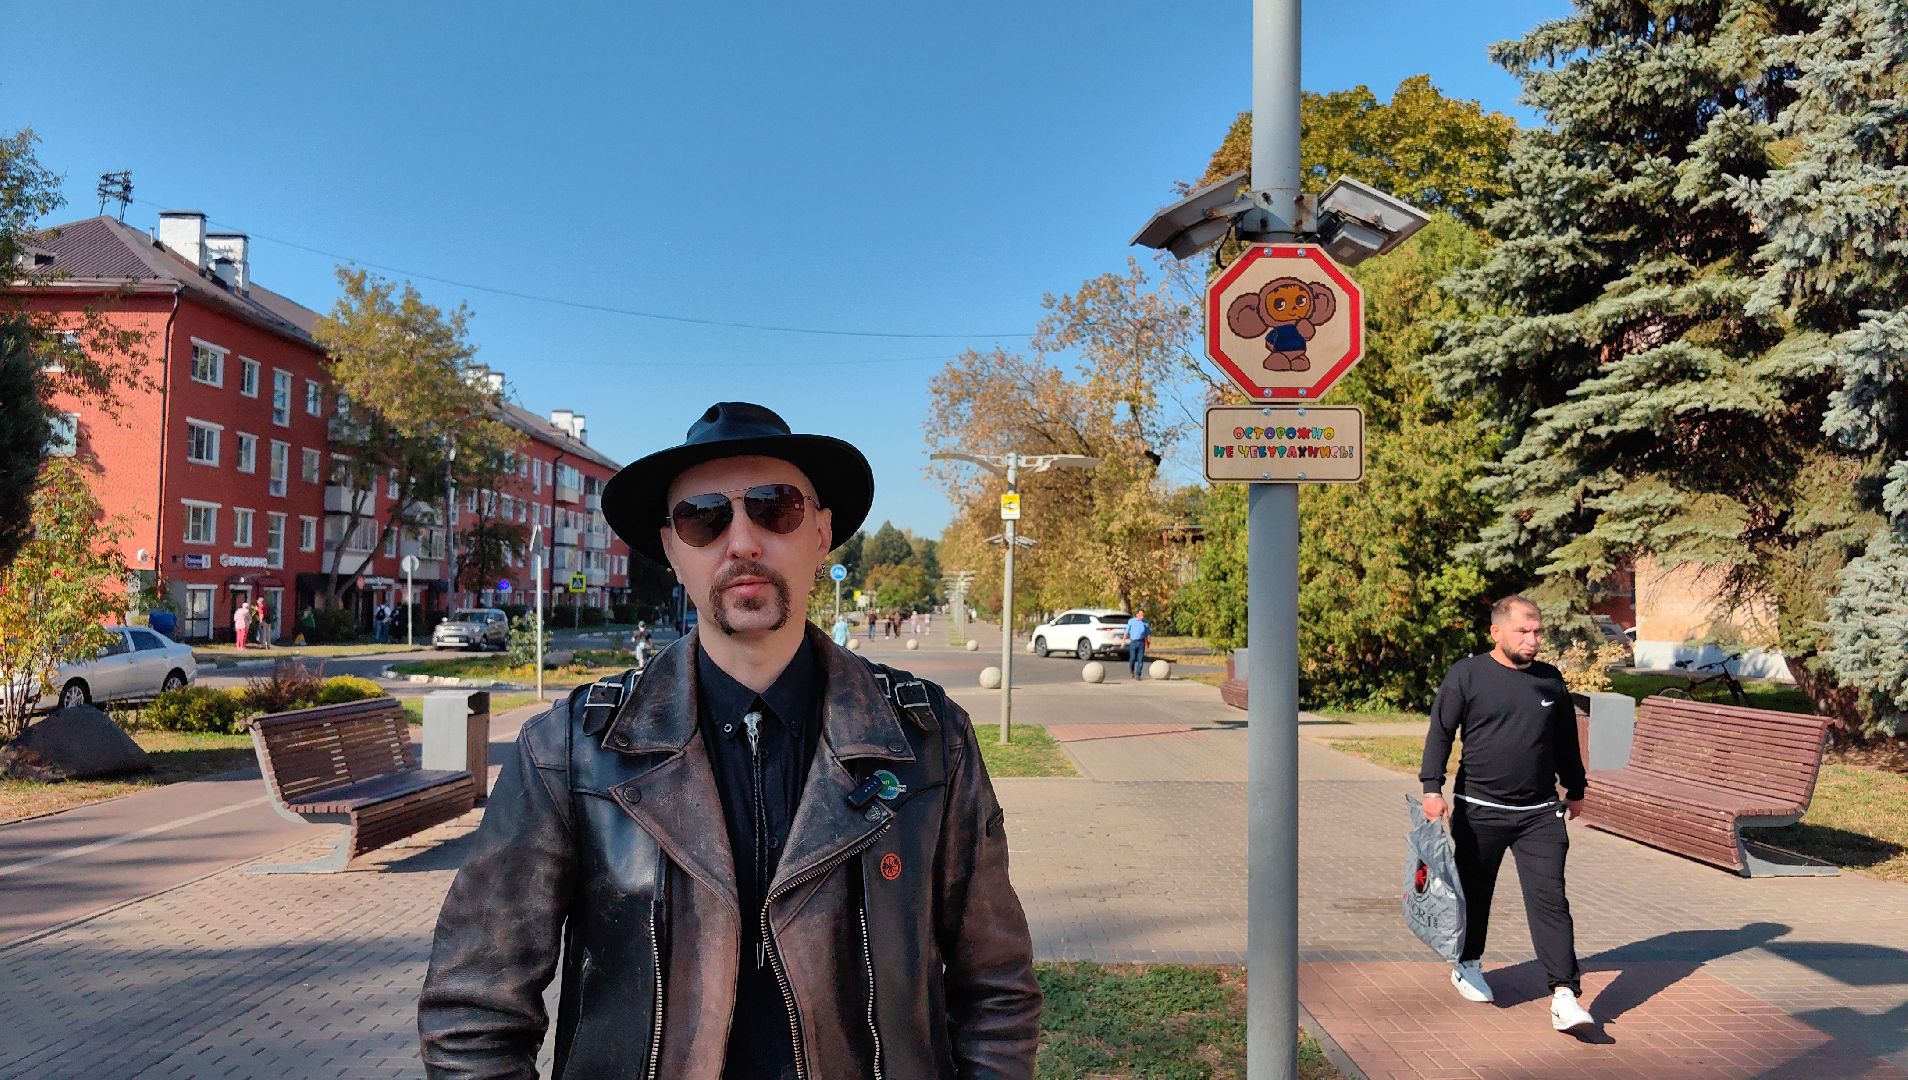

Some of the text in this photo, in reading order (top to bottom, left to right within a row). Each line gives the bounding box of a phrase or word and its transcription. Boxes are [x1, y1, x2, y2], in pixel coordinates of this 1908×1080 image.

[1233, 426, 1335, 440] ОСТОРОЖНО
[1213, 445, 1354, 459] НЕ ЧЕБУРАХНИСЬ!
